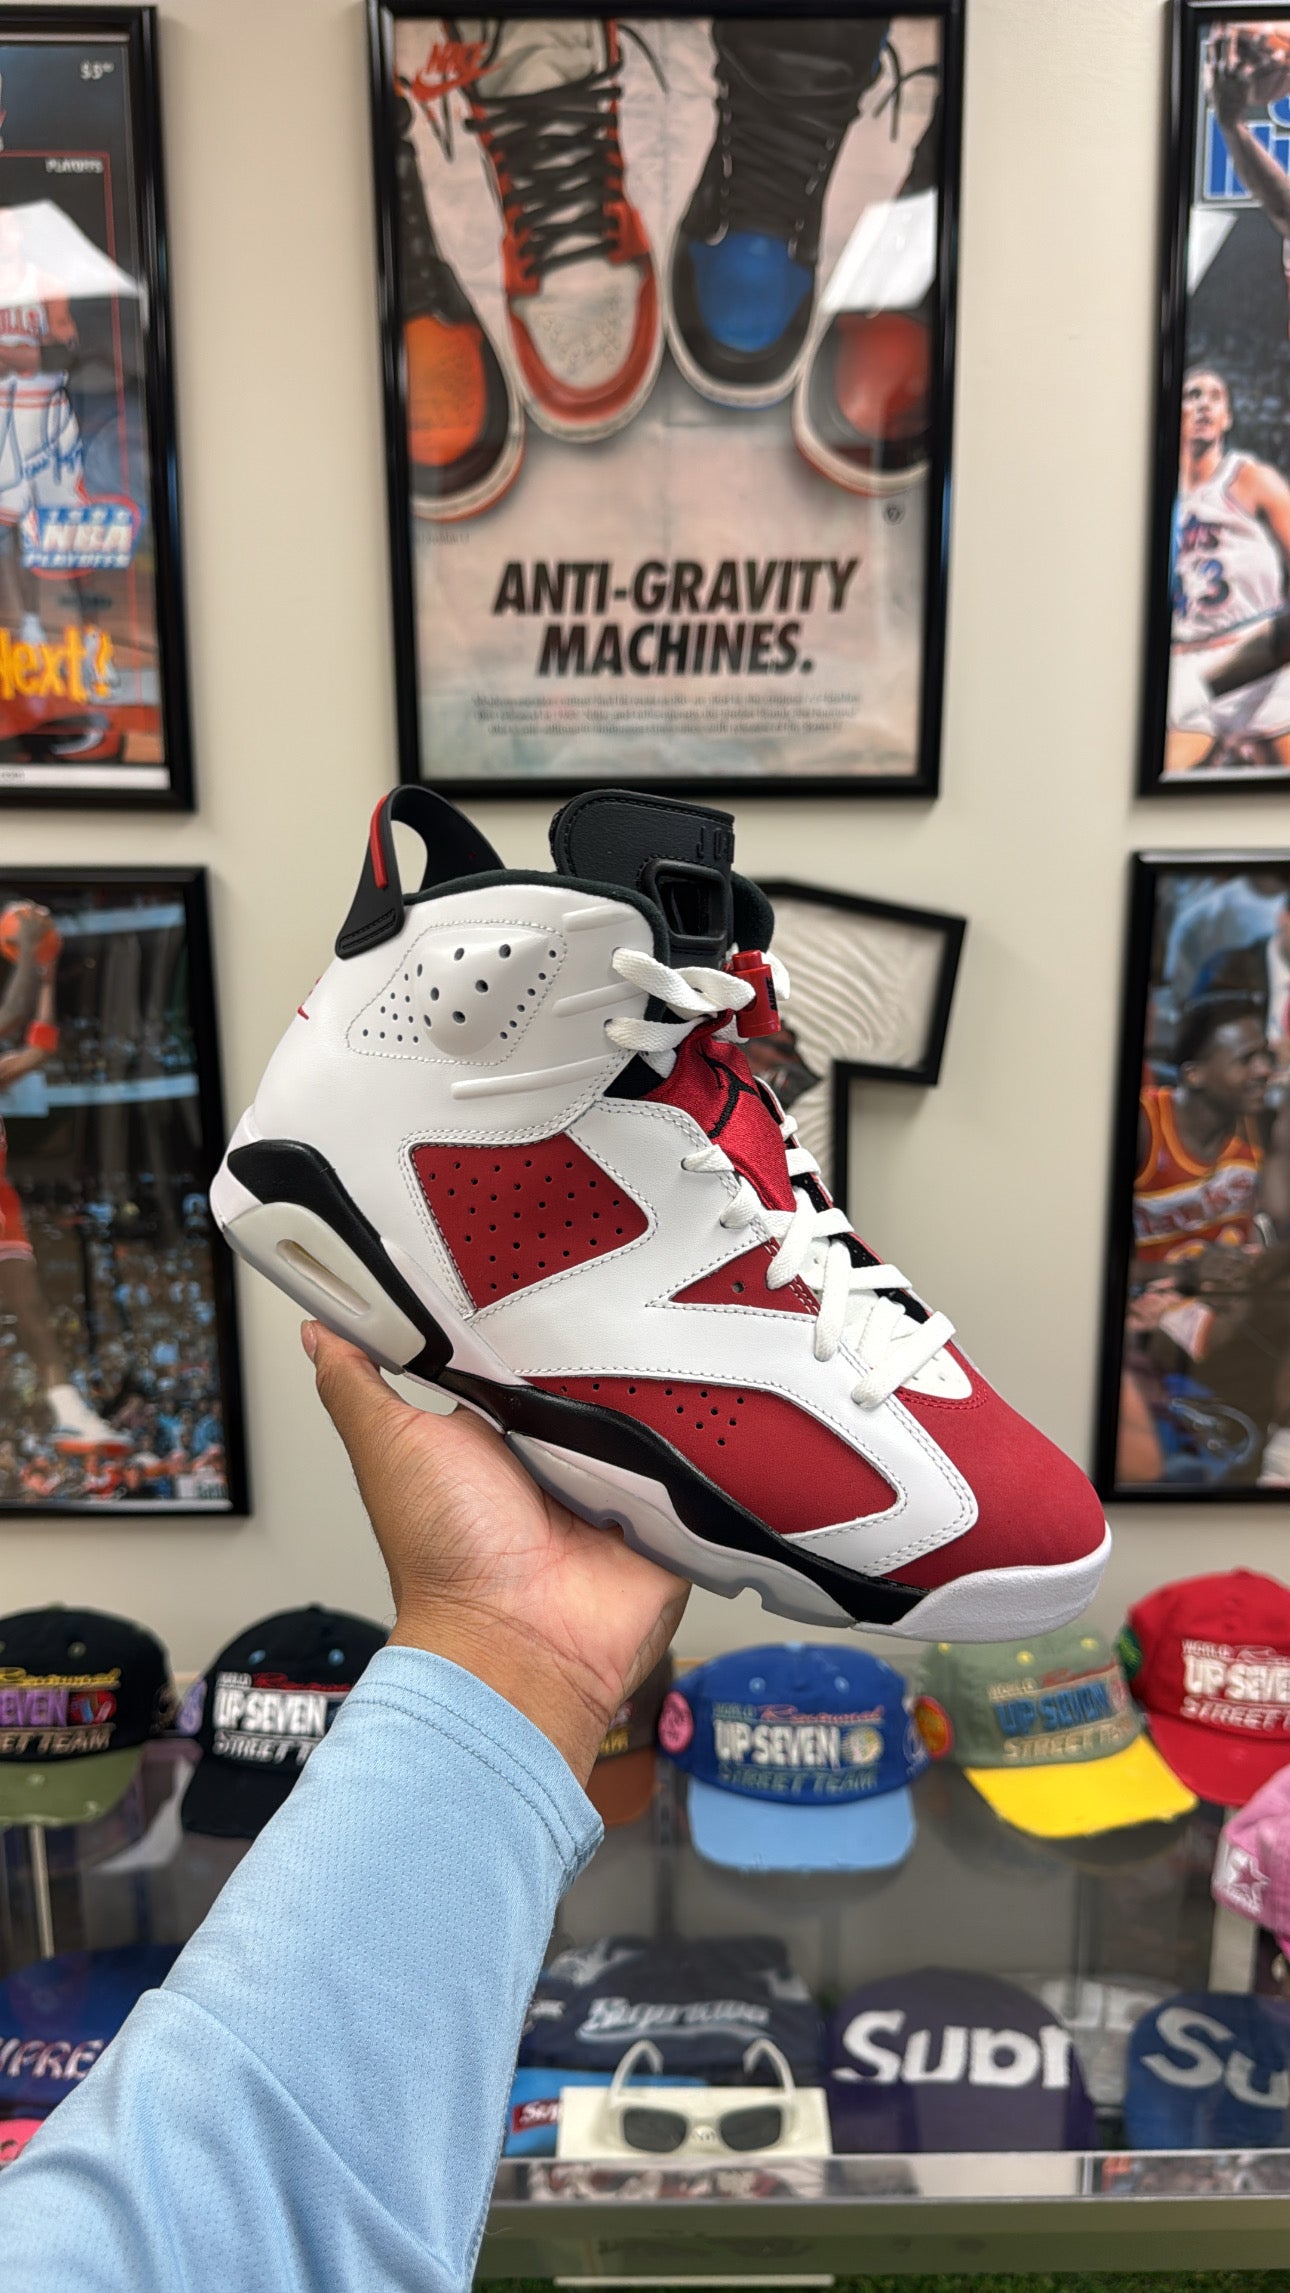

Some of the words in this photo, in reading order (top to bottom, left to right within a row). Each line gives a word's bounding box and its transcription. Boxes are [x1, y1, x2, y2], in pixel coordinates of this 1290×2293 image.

[42, 523, 132, 552] NBA
[491, 557, 860, 617] ANTI-GRAVITY
[536, 621, 815, 678] MACHINES.
[1183, 1655, 1226, 1697] UP
[242, 1691, 328, 1738] SEVEN
[1180, 1696, 1282, 1732] STREET
[37, 1724, 115, 1756] TEAM
[714, 1719, 752, 1763] UP
[751, 1724, 841, 1773] SEVEN
